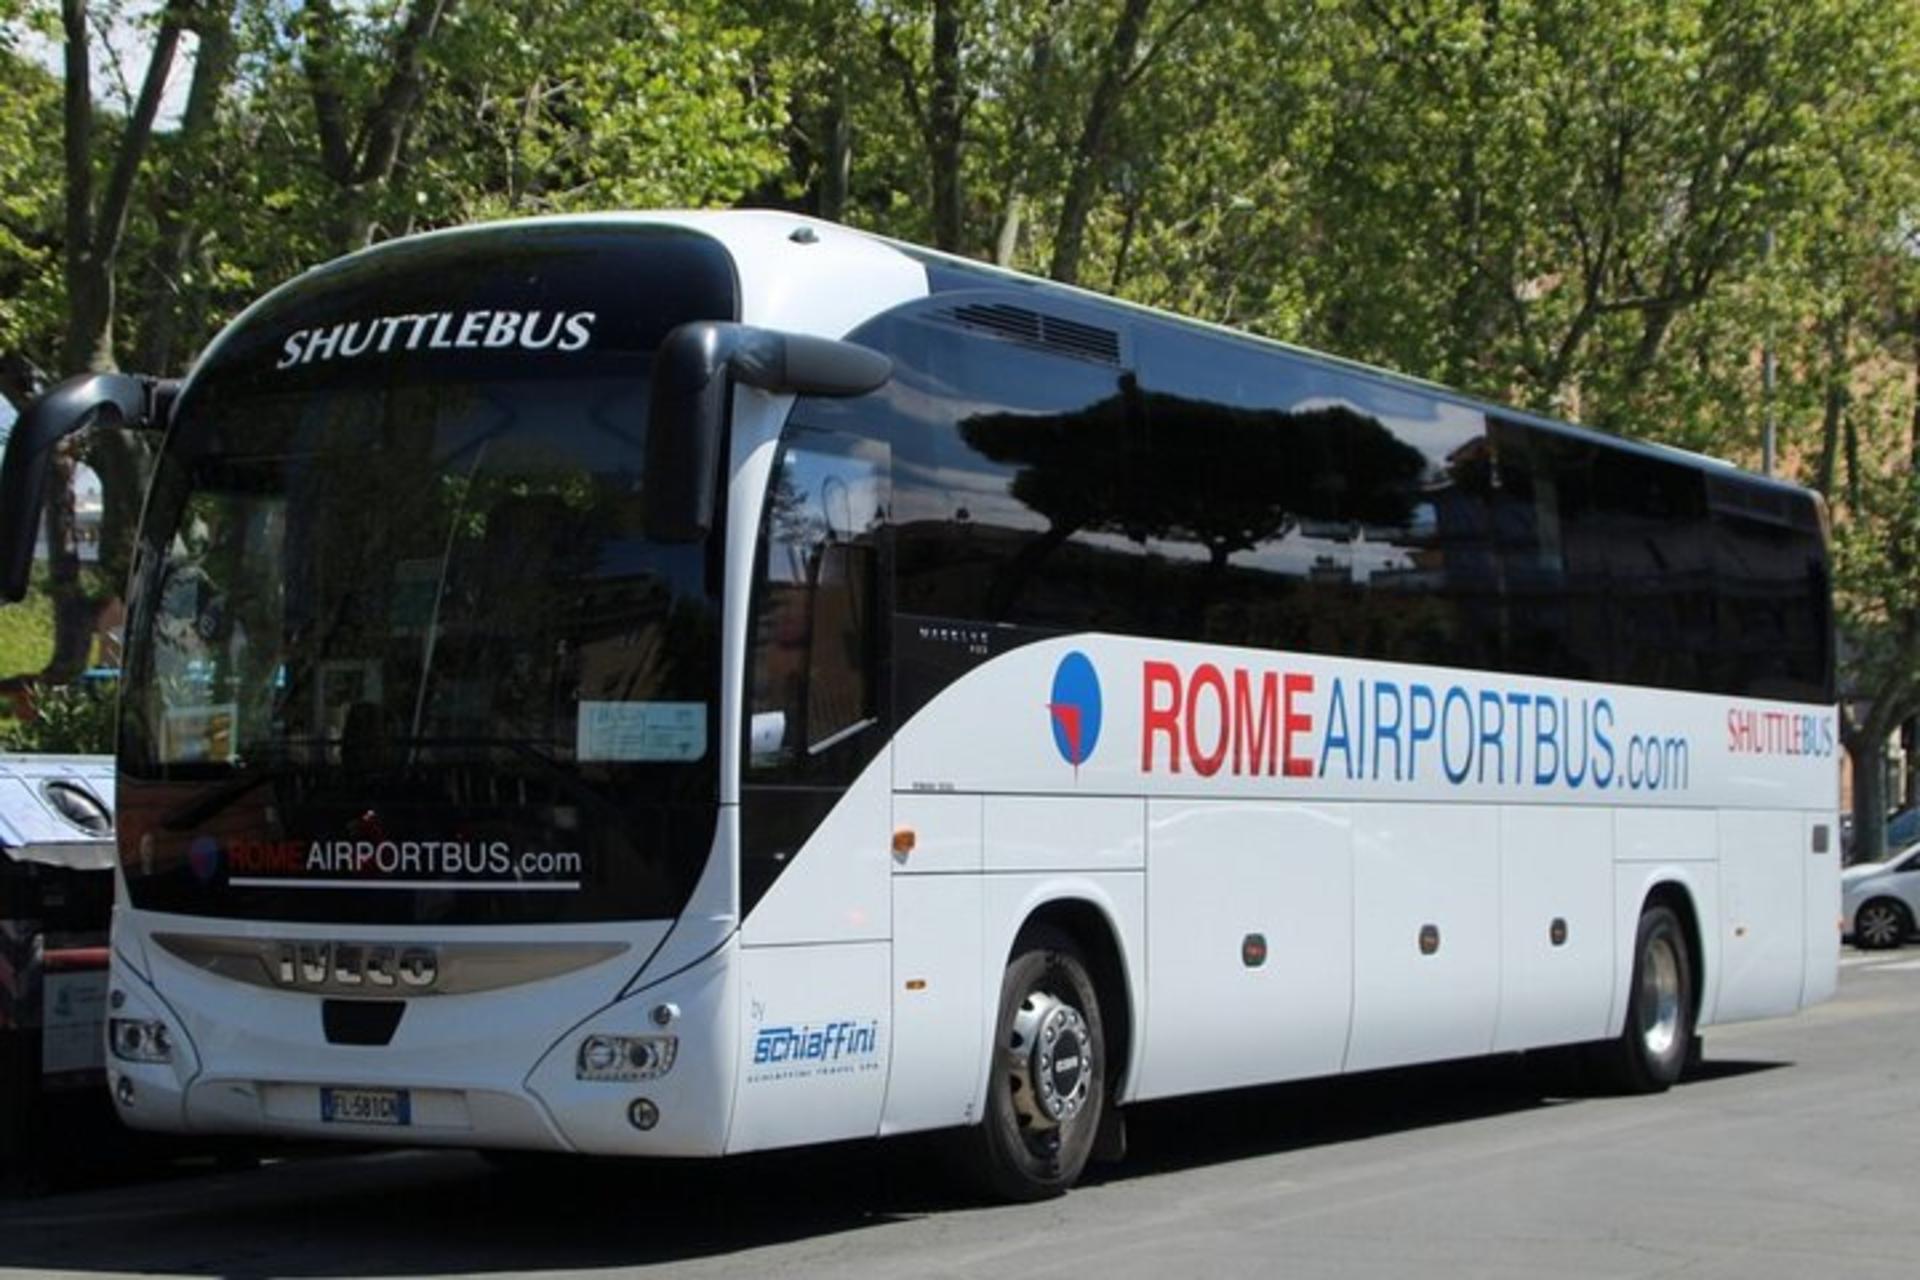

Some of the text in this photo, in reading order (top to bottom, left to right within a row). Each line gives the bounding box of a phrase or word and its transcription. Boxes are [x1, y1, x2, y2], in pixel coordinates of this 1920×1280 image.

[276, 309, 597, 369] SHUTTLEBUS
[1727, 708, 1834, 757] SHUTTLEBUS
[279, 942, 437, 986] IVECO
